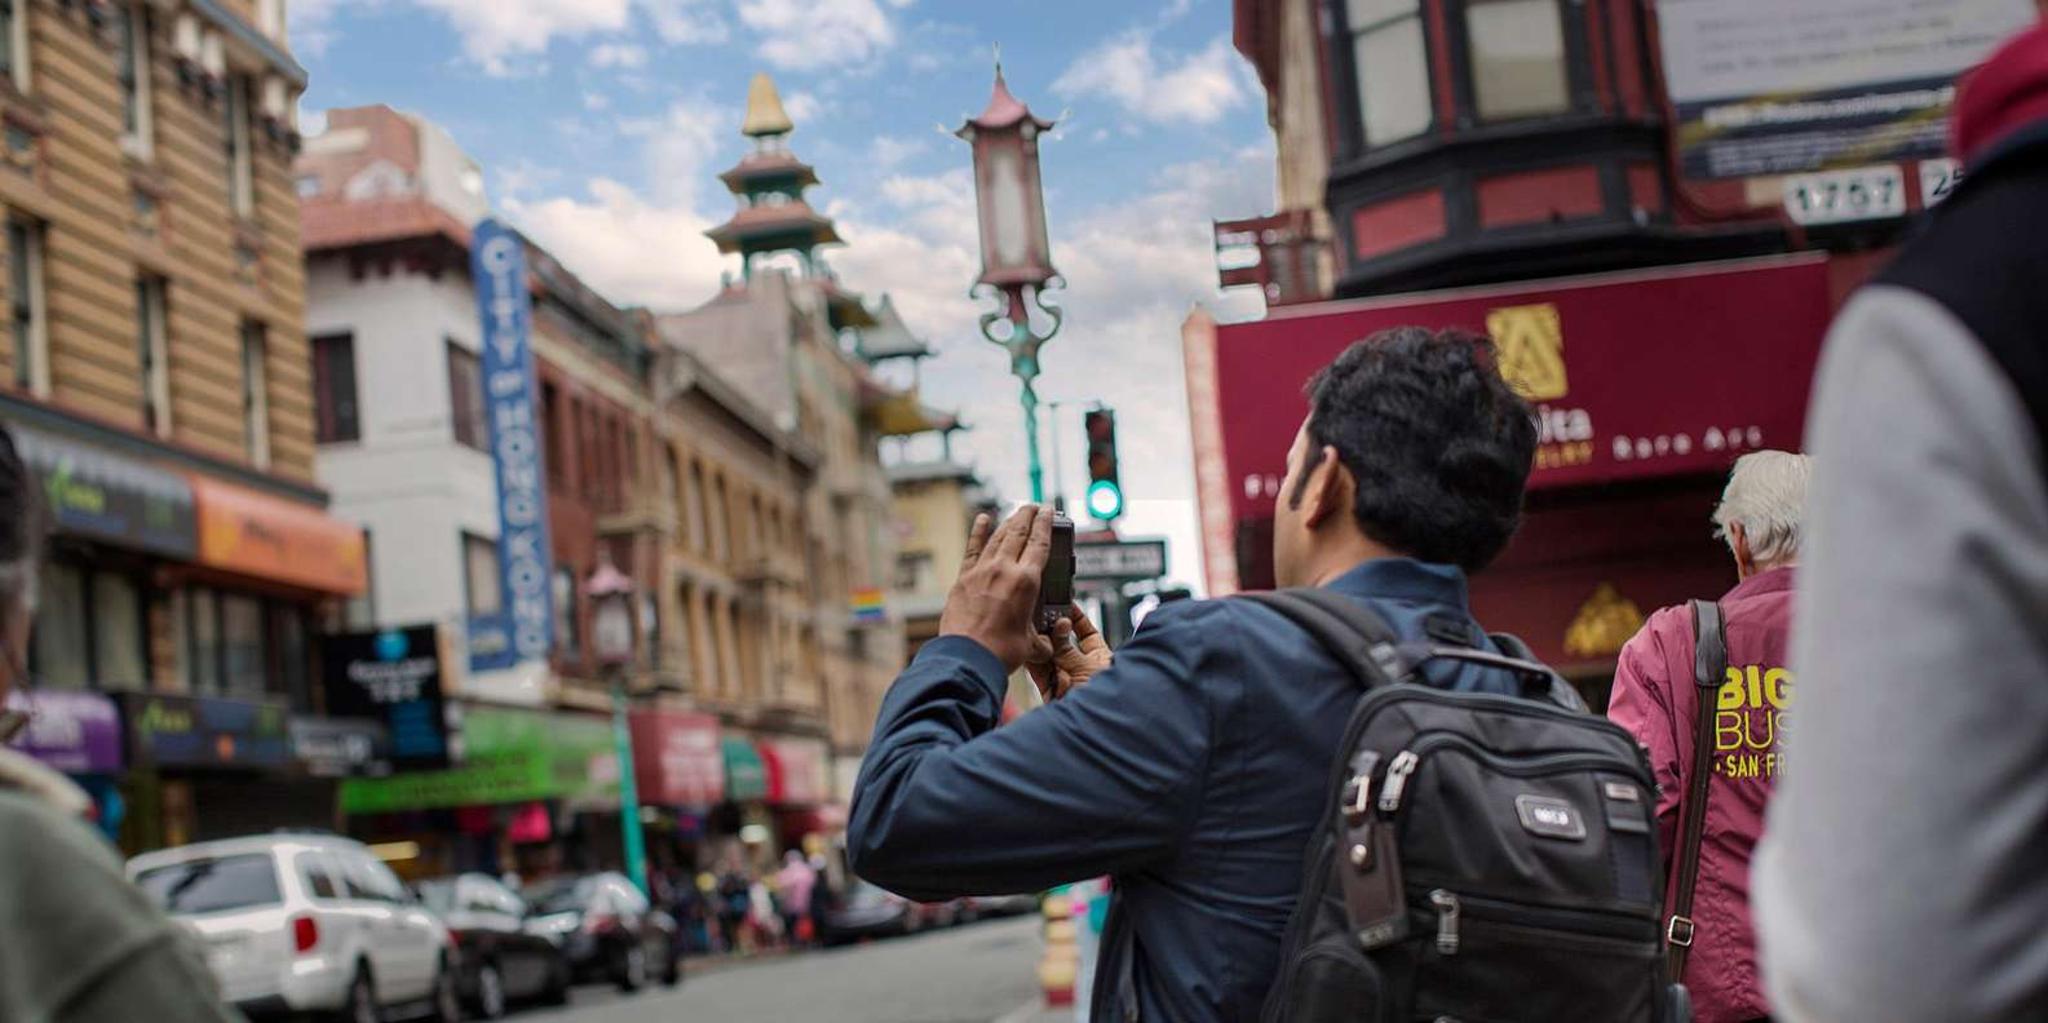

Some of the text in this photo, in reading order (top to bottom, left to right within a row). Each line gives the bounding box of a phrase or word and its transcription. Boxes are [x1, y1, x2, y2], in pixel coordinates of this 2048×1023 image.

[1538, 403, 1593, 444] ita
[495, 401, 541, 527] HONG
[507, 528, 549, 658] KONG
[1717, 665, 1797, 710] BIG
[1726, 753, 1760, 778] SAN
